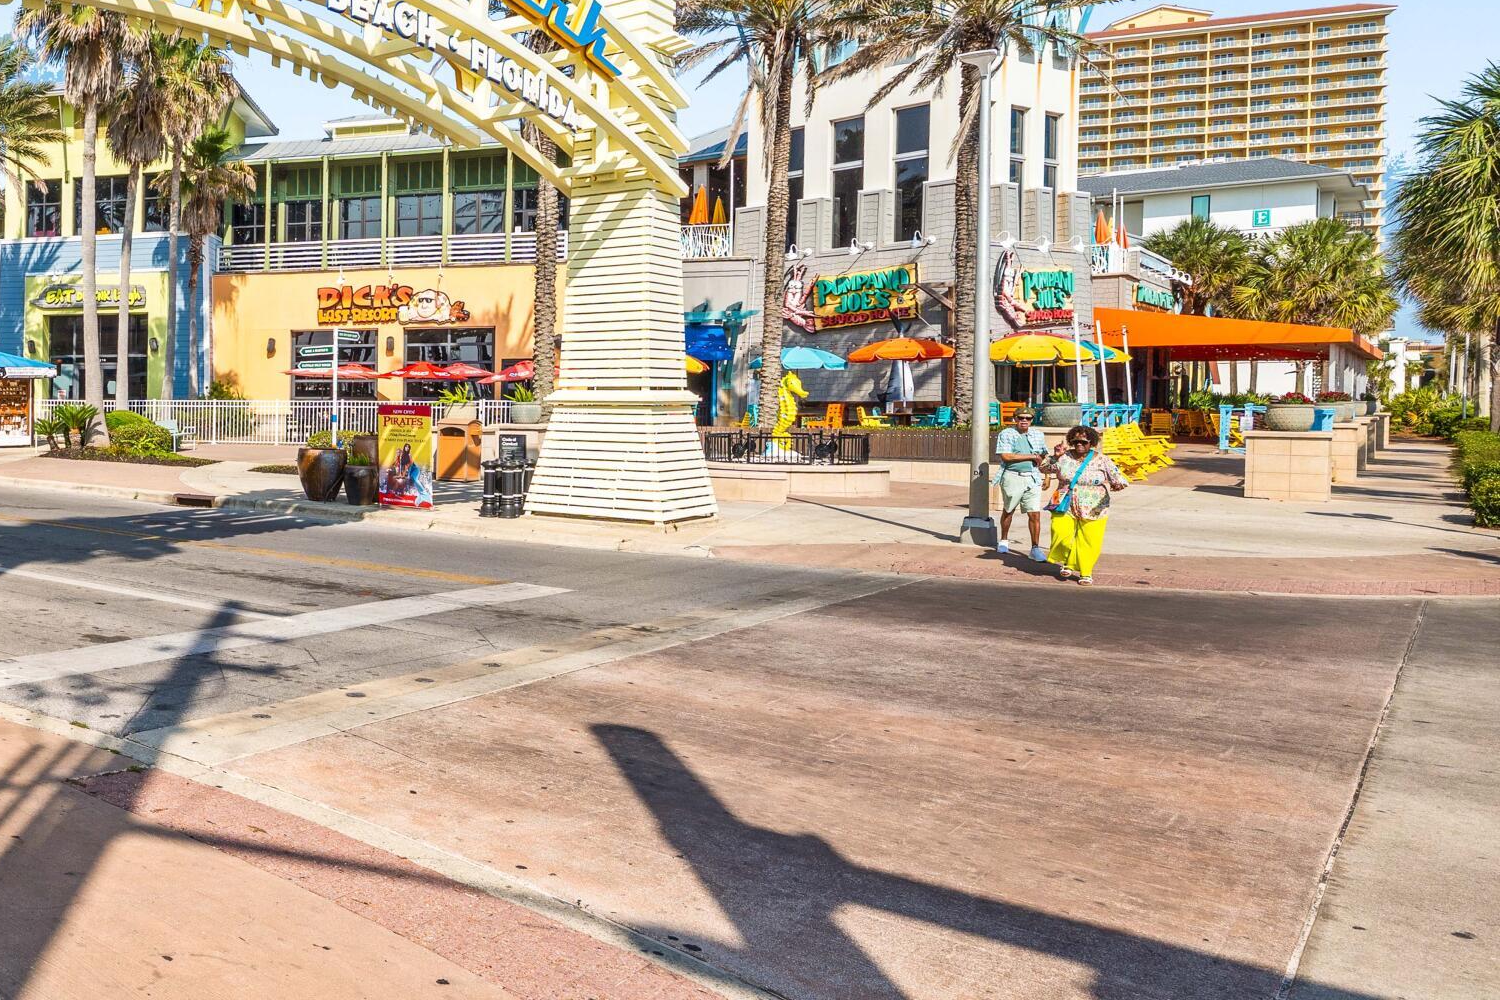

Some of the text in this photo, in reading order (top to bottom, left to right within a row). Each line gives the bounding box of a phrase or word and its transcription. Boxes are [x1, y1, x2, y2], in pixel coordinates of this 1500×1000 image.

[470, 37, 586, 133] FLORIDA
[45, 288, 76, 304] EAT
[318, 283, 413, 309] DICK'S
[815, 267, 911, 308] POMPANO
[835, 289, 891, 314] JOE'S
[318, 307, 398, 325] LAST RESORT
[821, 312, 870, 328] SEAFOOD
[383, 416, 424, 427] PIRATES
